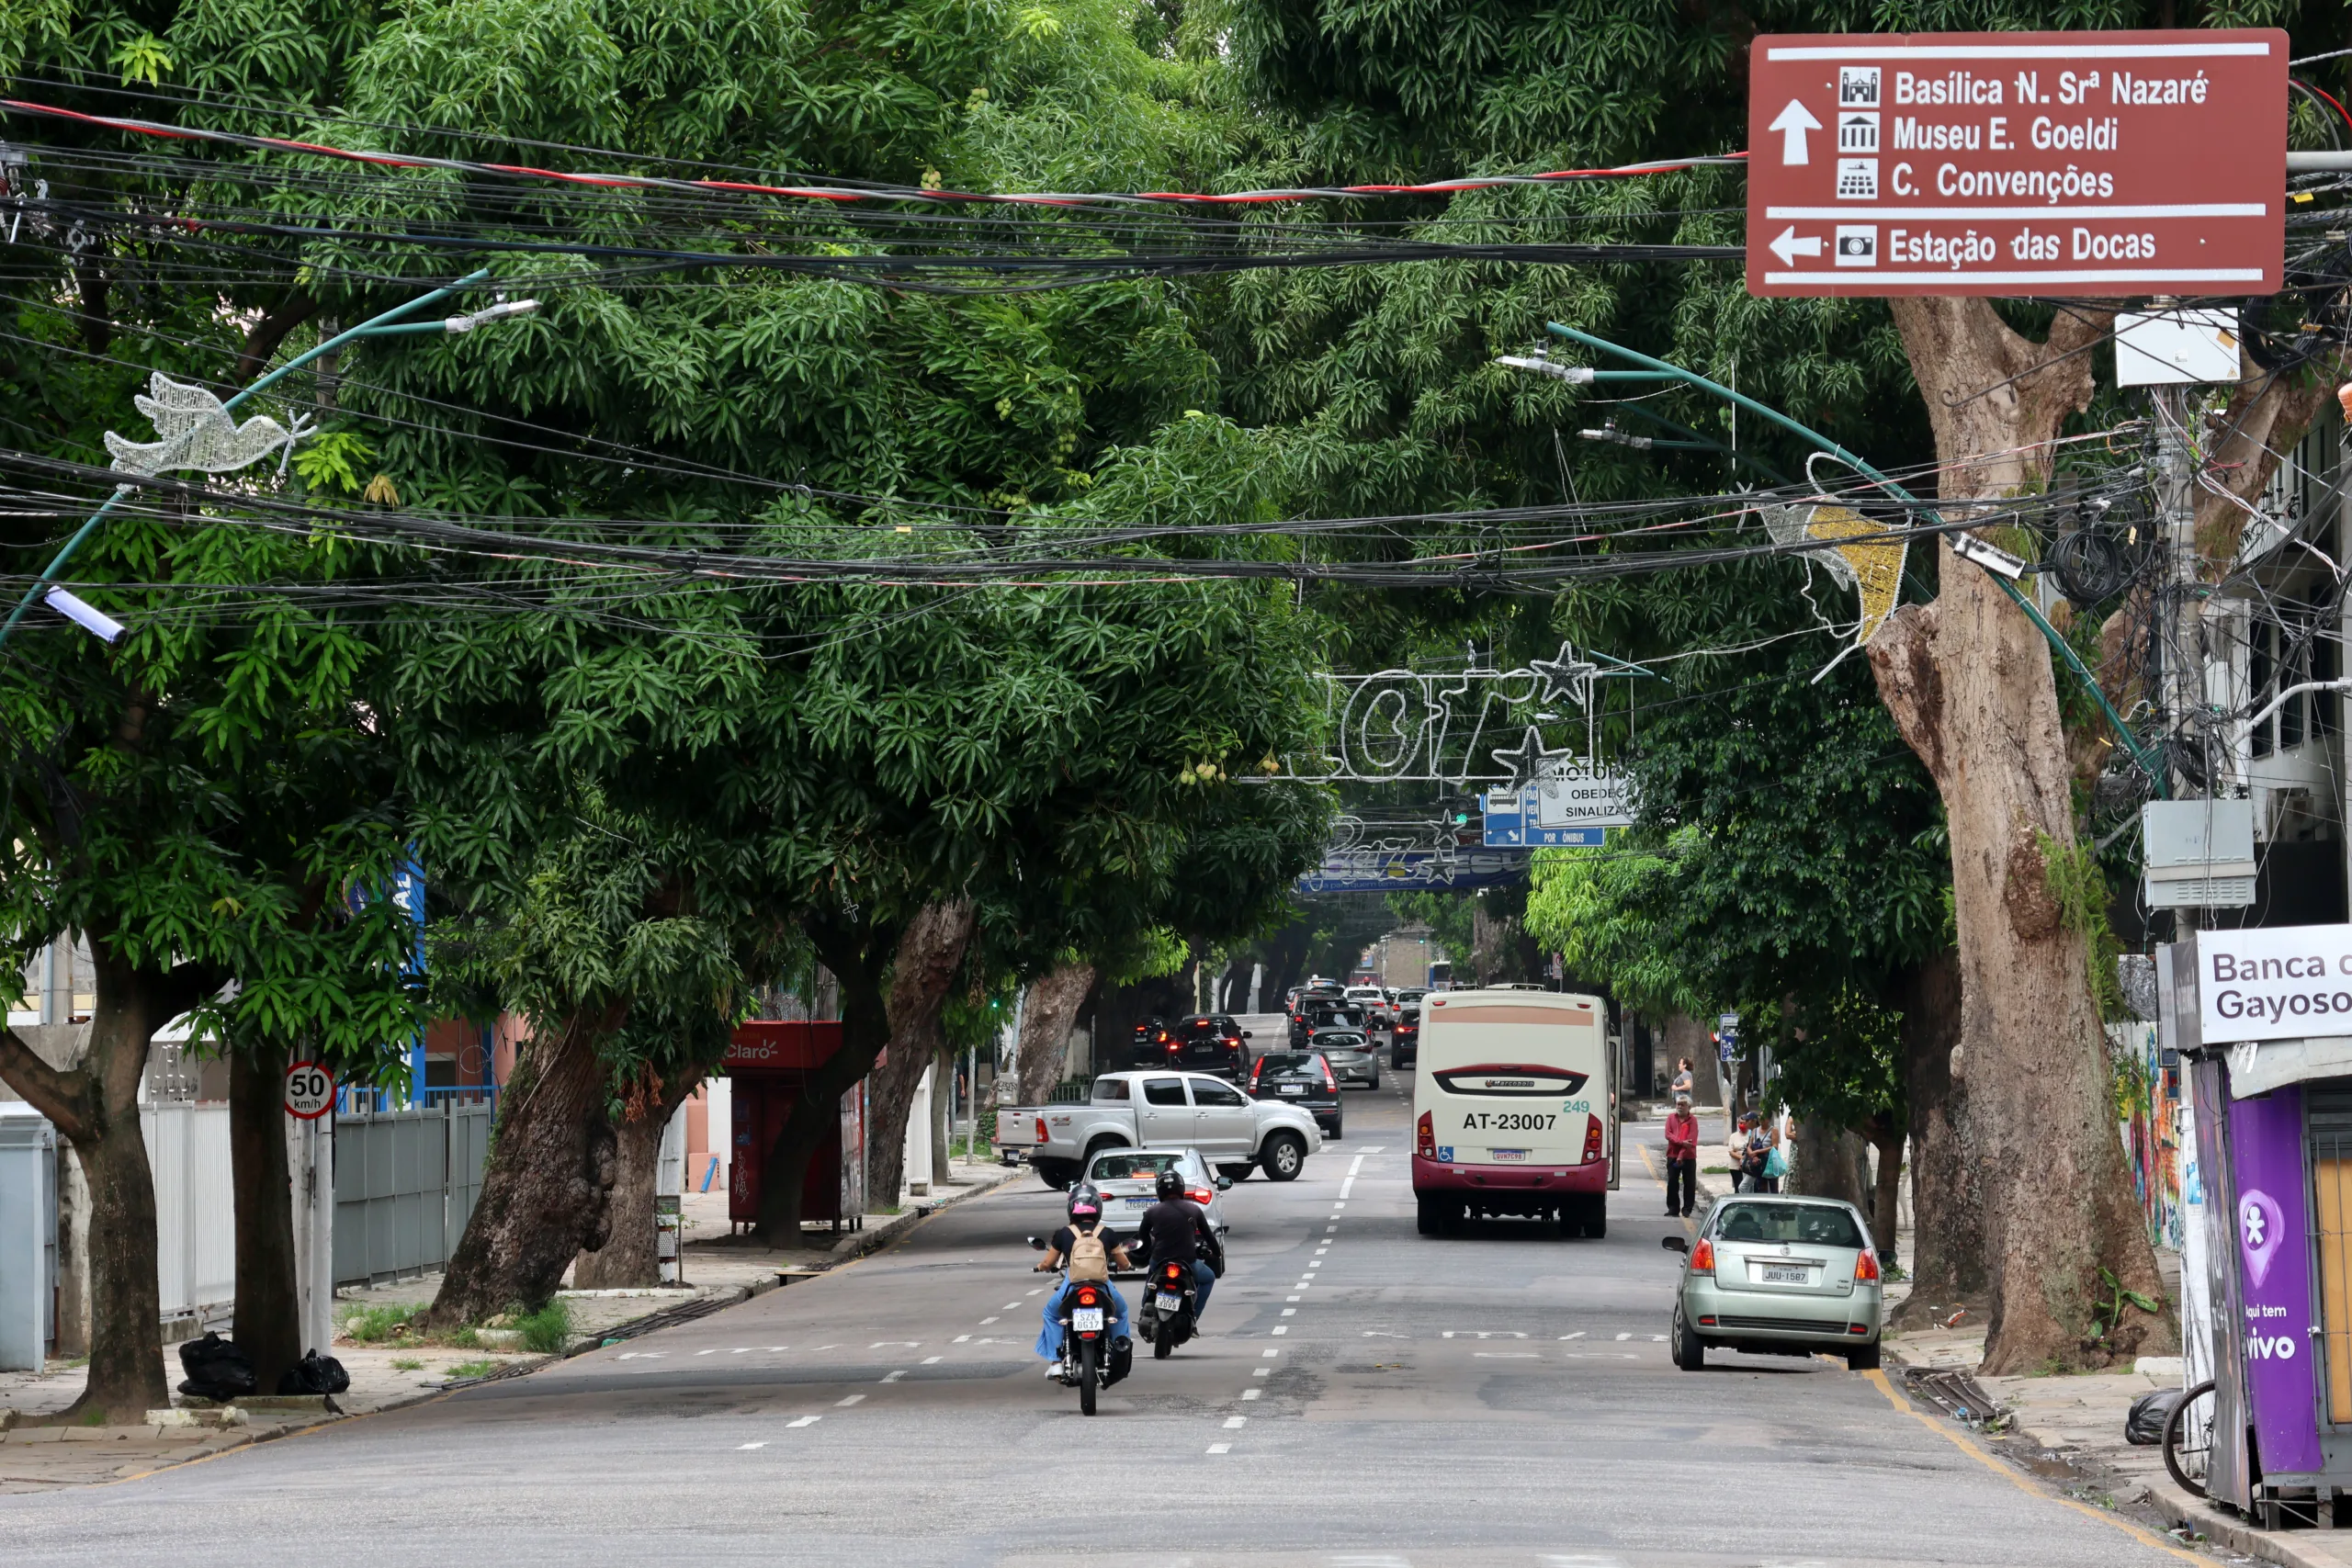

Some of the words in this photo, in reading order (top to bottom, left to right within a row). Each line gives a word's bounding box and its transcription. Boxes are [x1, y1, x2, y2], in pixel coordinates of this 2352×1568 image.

[1894, 71, 2003, 106] Basílica
[2017, 71, 2049, 104] N.
[2112, 70, 2207, 105] Nazaré
[1894, 117, 1980, 151] Museu
[1989, 118, 2015, 150] E.
[2031, 117, 2119, 152] Goeldi
[1892, 163, 1920, 196] C.
[1937, 163, 2114, 203] Convenções
[1890, 229, 1996, 269] Estação
[2013, 227, 2060, 261] das
[2073, 227, 2156, 261] Docas
[1544, 832, 1556, 843] POR
[2212, 953, 2326, 983] Banca
[2216, 989, 2352, 1025] Gayoso
[290, 1074, 325, 1097] 50
[294, 1098, 321, 1109] km/h
[1563, 1100, 1590, 1113] 249
[1463, 1113, 1556, 1131] AT-23007
[1080, 1313, 1097, 1321] SZK
[2262, 1303, 2287, 1318] tem
[2246, 1325, 2296, 1359] vivo
